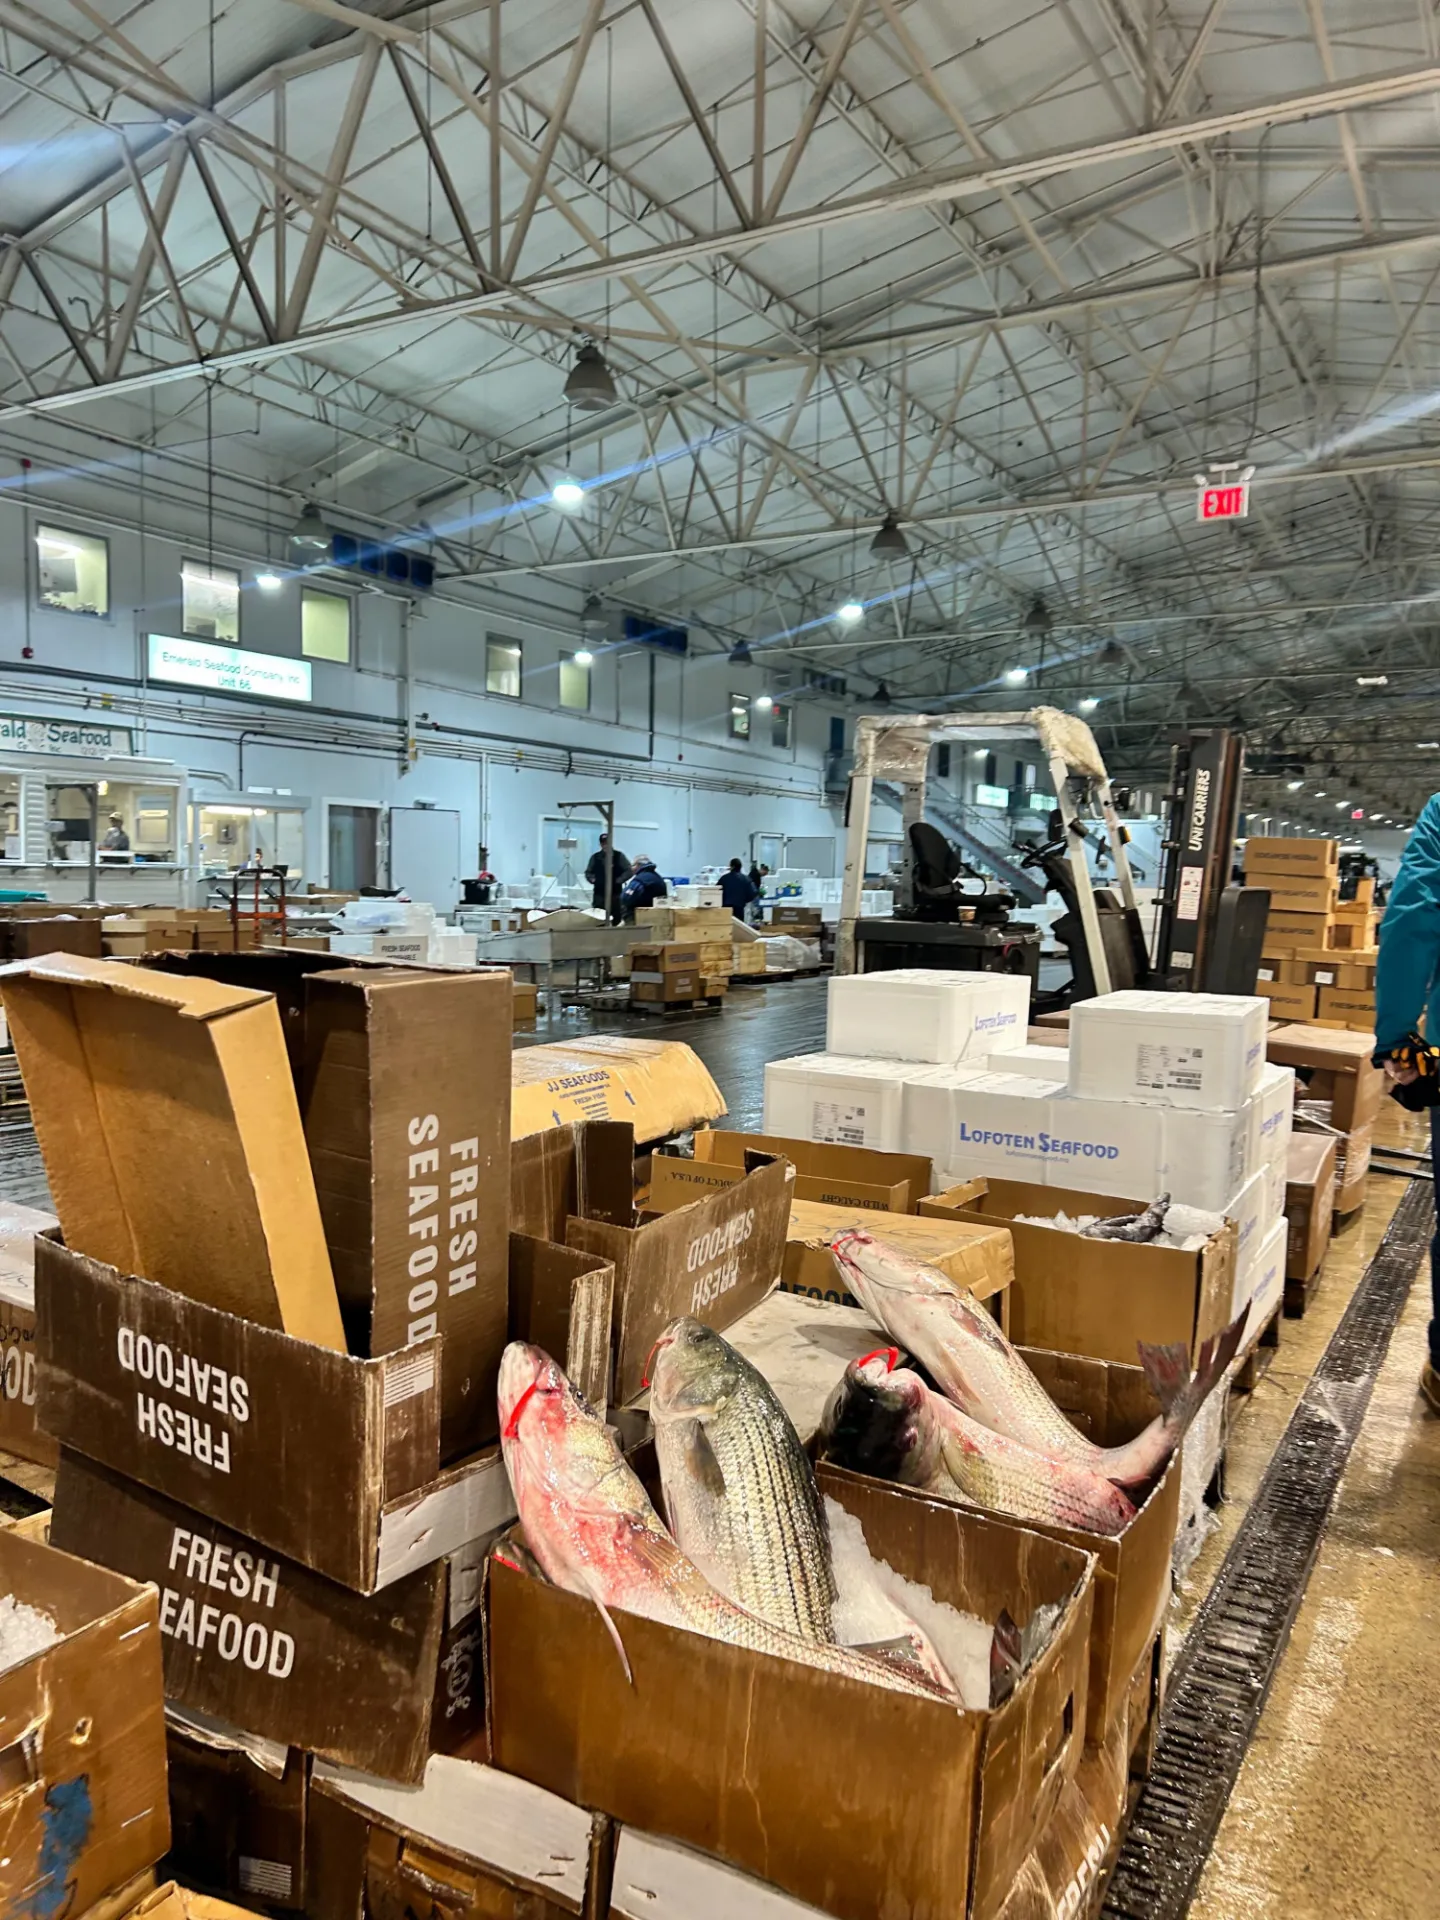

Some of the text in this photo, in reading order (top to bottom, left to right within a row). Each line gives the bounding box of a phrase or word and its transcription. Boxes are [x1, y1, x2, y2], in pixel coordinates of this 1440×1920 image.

[1203, 486, 1242, 518] EXIT
[162, 651, 201, 668] Emerald
[203, 658, 242, 675] Seafood
[217, 675, 236, 688] Unit
[47, 723, 112, 746] Seafood
[547, 1082, 559, 1092] JJ
[559, 1070, 610, 1089] SEAFOODS
[960, 1122, 1120, 1160] LOFOTEN SEAFOOD
[693, 1175, 705, 1184] OF
[820, 1193, 889, 1211] WILD CAUGHT
[407, 1114, 439, 1345] SEAFOOD
[449, 1137, 479, 1297] FRESH
[687, 1207, 755, 1273] SEAFOOD
[690, 1256, 740, 1313] FRESH
[117, 1326, 249, 1422] SEAFOOD
[136, 1391, 231, 1474] FRESH
[168, 1527, 280, 1608] FRESH
[159, 1587, 295, 1679] EAFOOD
